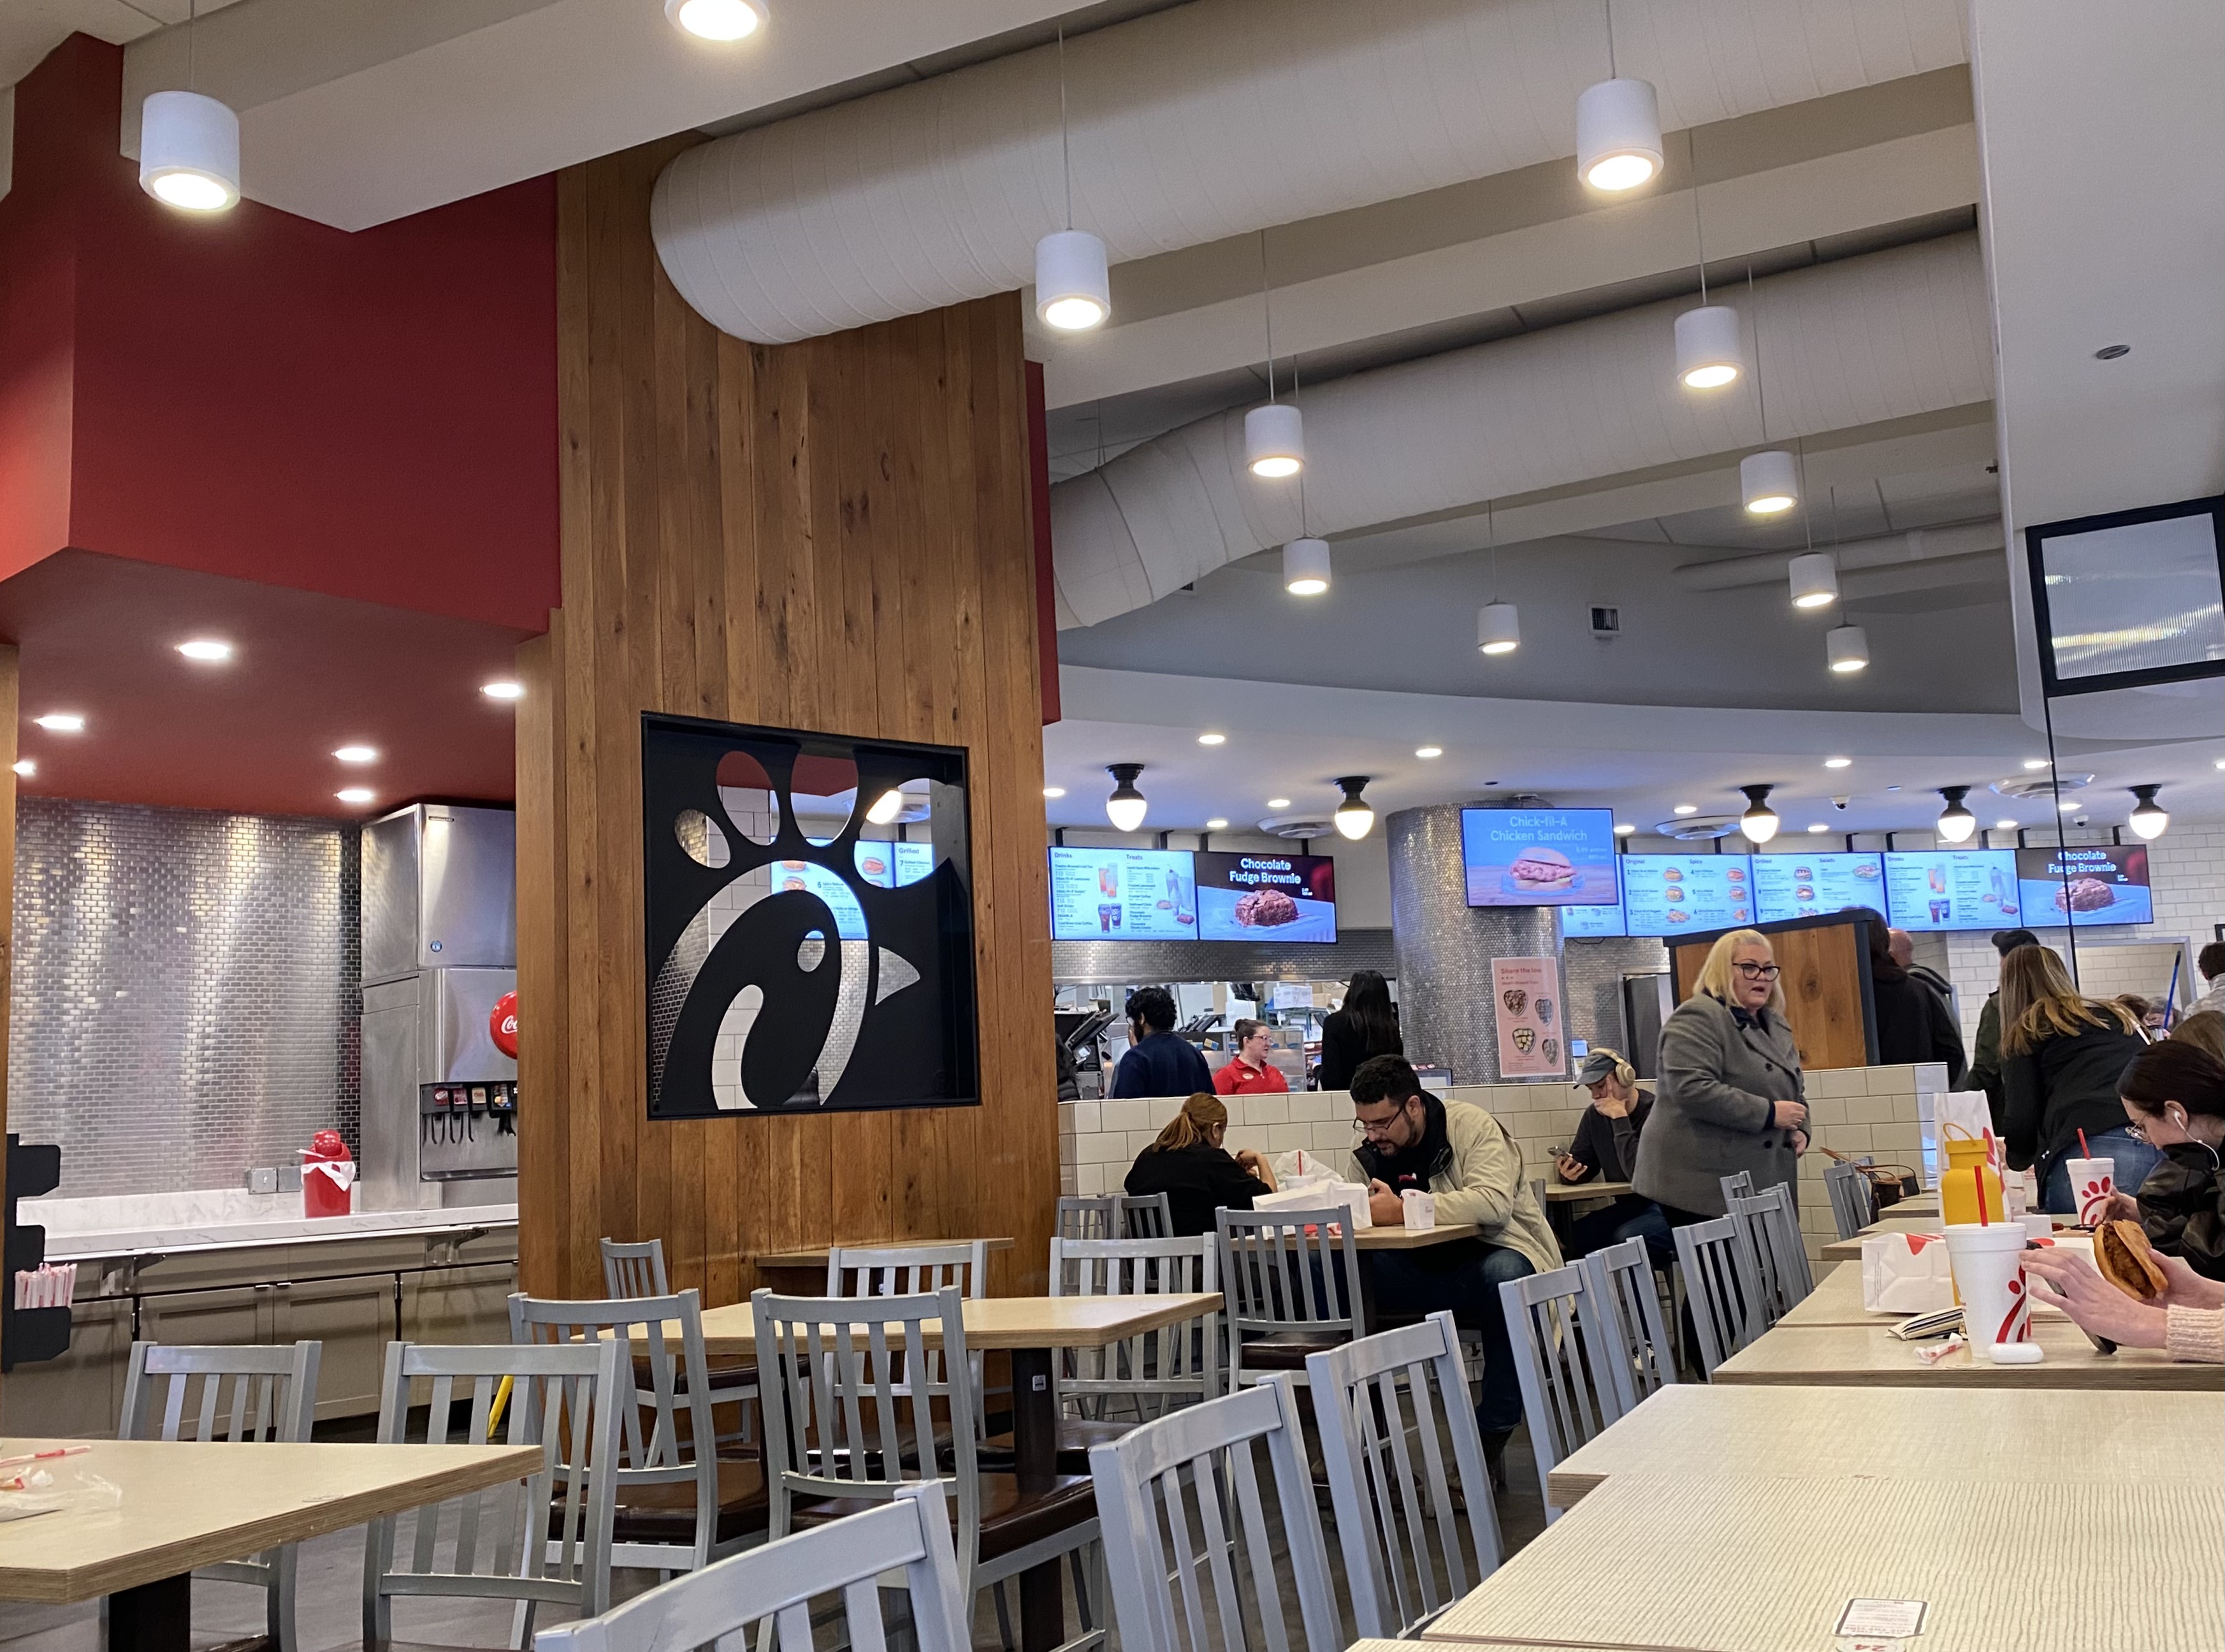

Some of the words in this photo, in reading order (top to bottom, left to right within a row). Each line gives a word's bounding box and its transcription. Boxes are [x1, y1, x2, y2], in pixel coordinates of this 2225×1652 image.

[1509, 816, 1568, 827] Chick-fil-A
[1490, 830, 1534, 841] Chicken
[1537, 830, 1587, 841] Sandwich
[1240, 858, 1291, 871] Chocolate
[2078, 862, 2117, 872] Brownie
[1229, 871, 1259, 885] Fudge
[1261, 872, 1301, 884] Brownie
